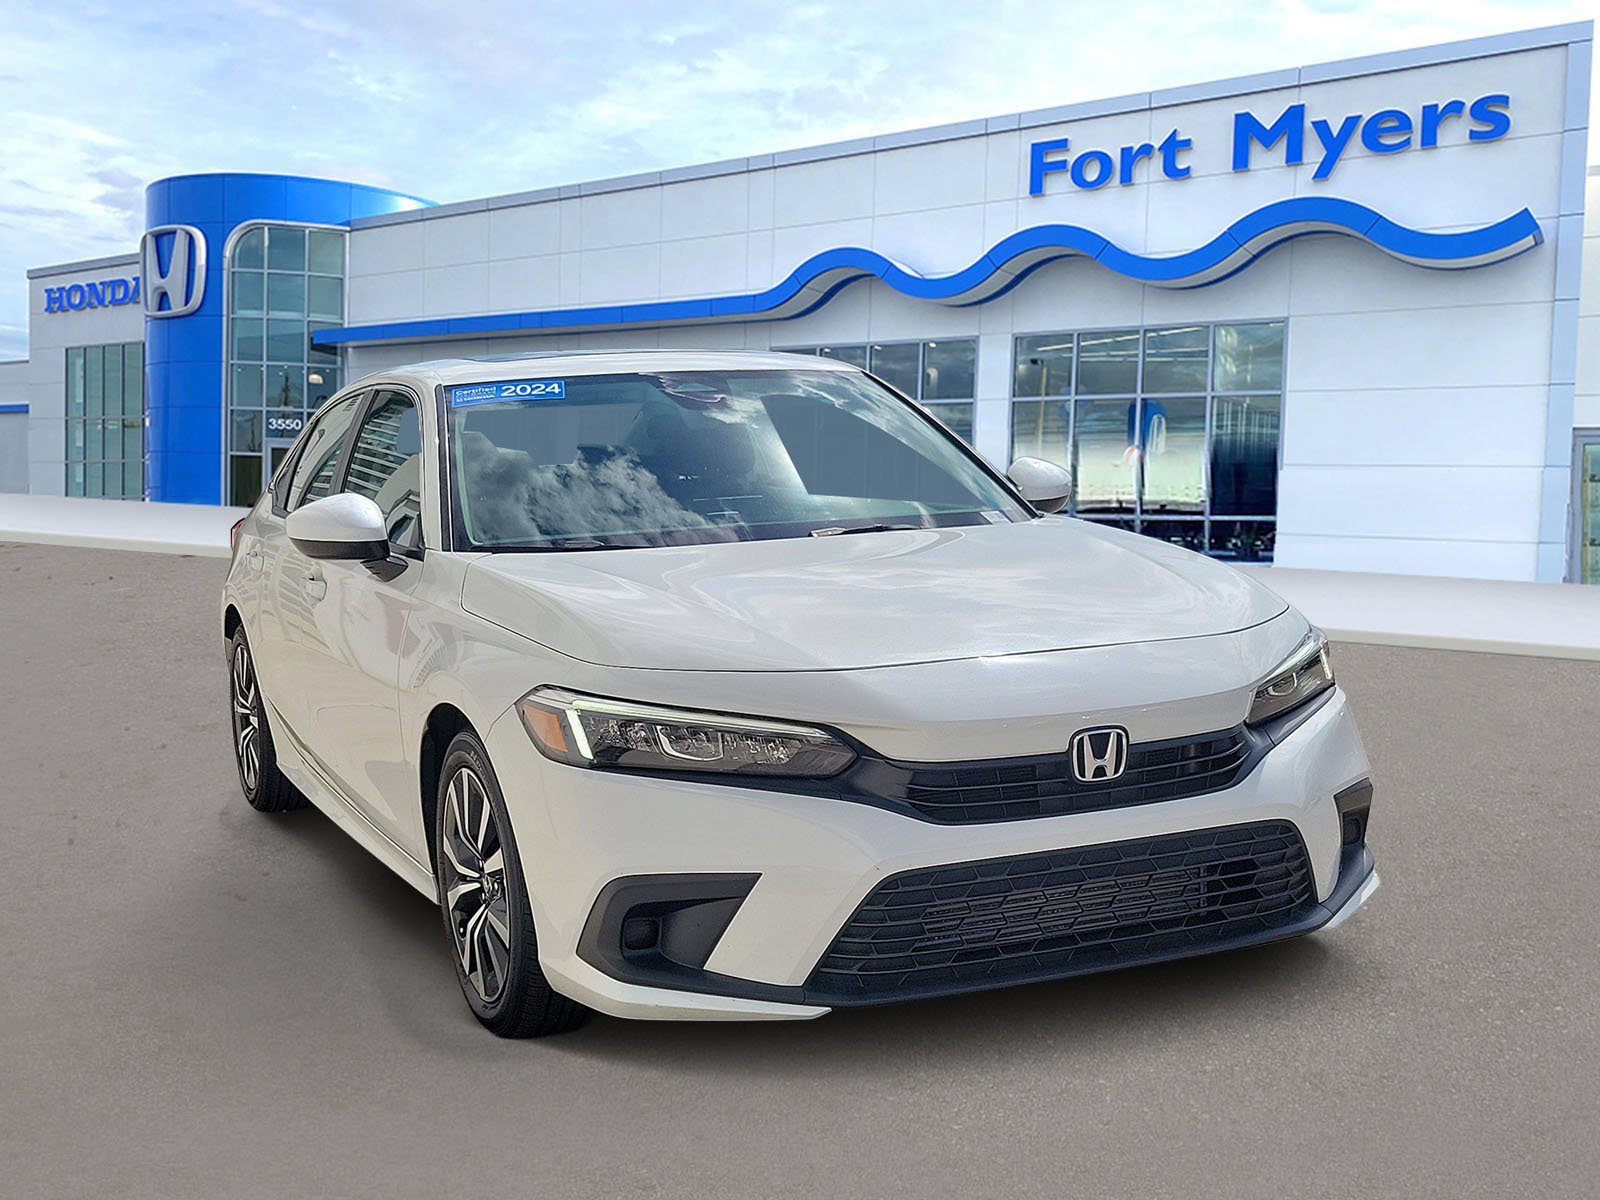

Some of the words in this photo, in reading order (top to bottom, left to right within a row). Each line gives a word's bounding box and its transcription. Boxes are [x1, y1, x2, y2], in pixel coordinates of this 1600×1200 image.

[1029, 130, 1193, 197] Fort
[1231, 94, 1511, 182] Myers
[456, 386, 496, 395] Certified
[501, 383, 561, 396] 2024
[268, 418, 302, 430] 3550
